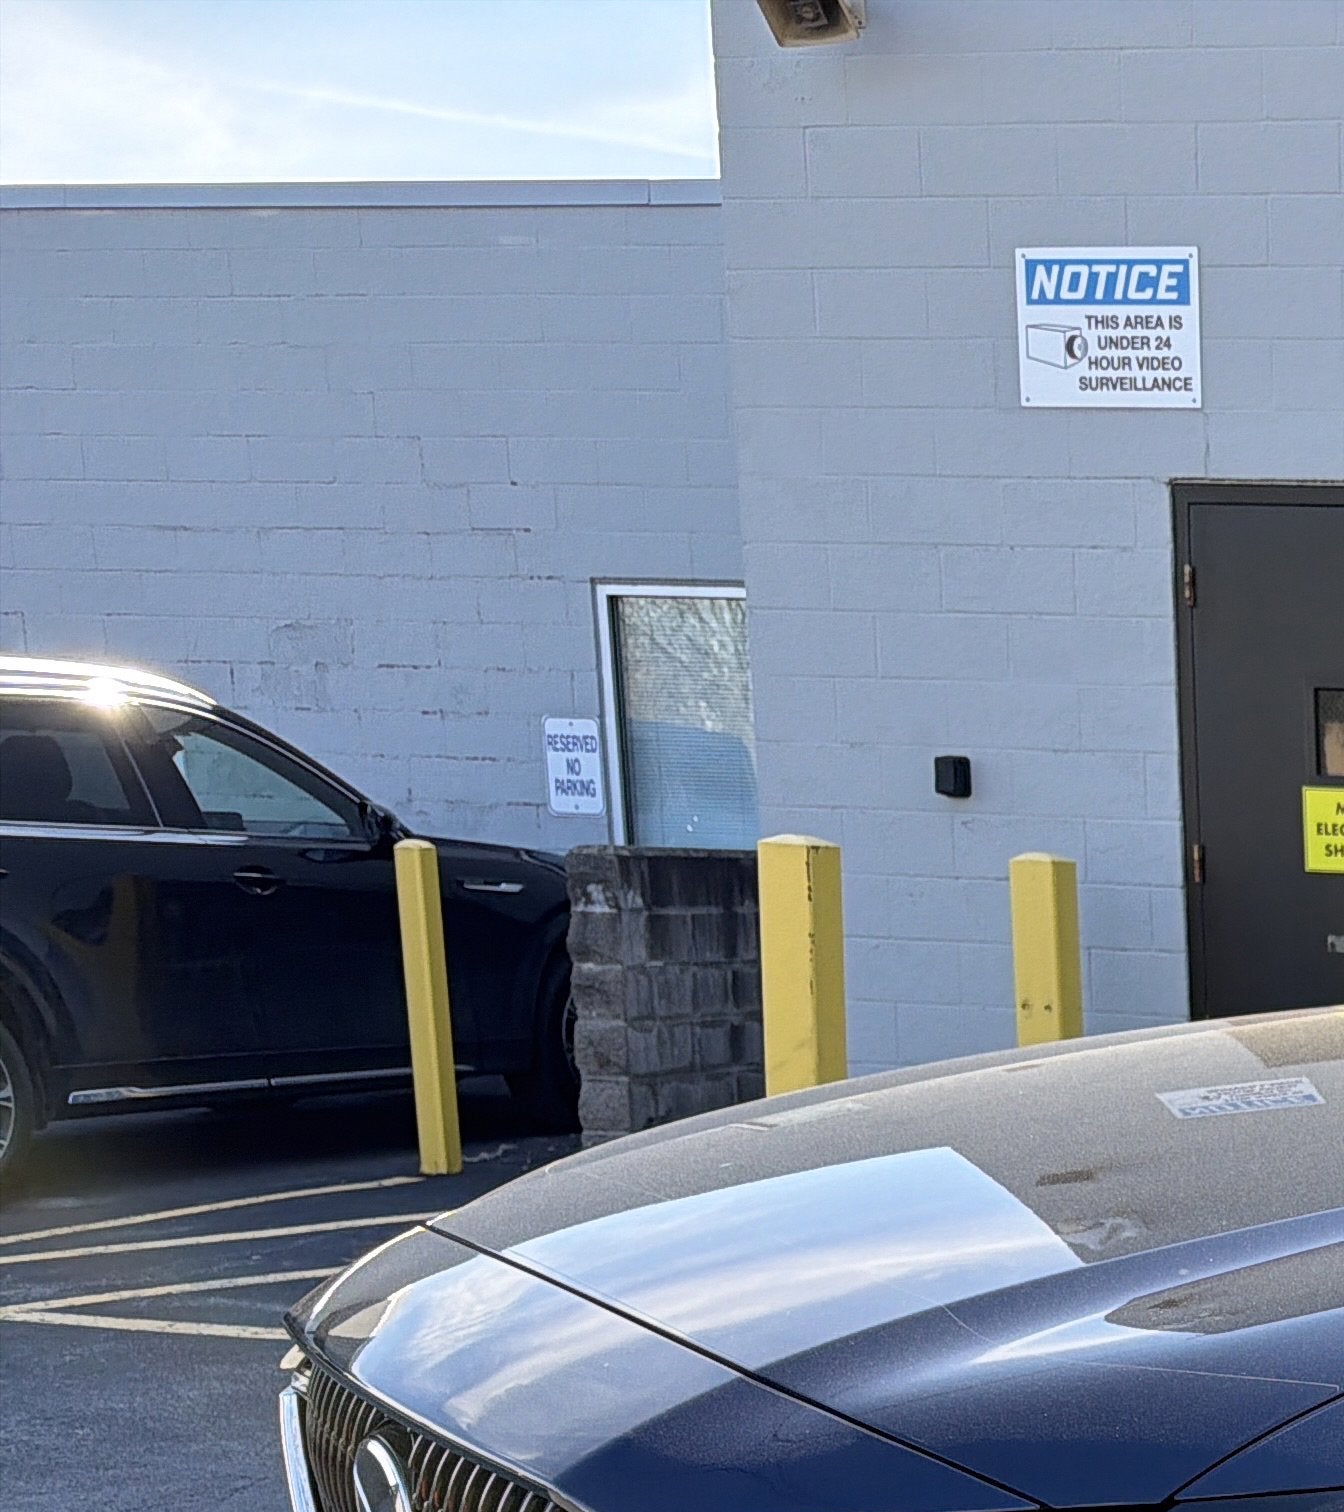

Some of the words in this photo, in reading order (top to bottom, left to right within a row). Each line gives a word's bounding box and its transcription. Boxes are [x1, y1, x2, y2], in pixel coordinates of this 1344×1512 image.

[1031, 264, 1184, 300] NOTICE
[1085, 314, 1119, 330] THIS
[1123, 315, 1165, 330] AREA
[1169, 315, 1183, 330] IS
[1097, 335, 1151, 351] UNDER
[1155, 336, 1172, 350] 24
[1088, 356, 1132, 371] HOUR
[1136, 356, 1182, 371] VIDEO
[1078, 376, 1193, 392] SURVEILLANCE
[547, 733, 598, 753] RESERVED
[566, 757, 582, 776] NO
[555, 777, 597, 798] PARKING
